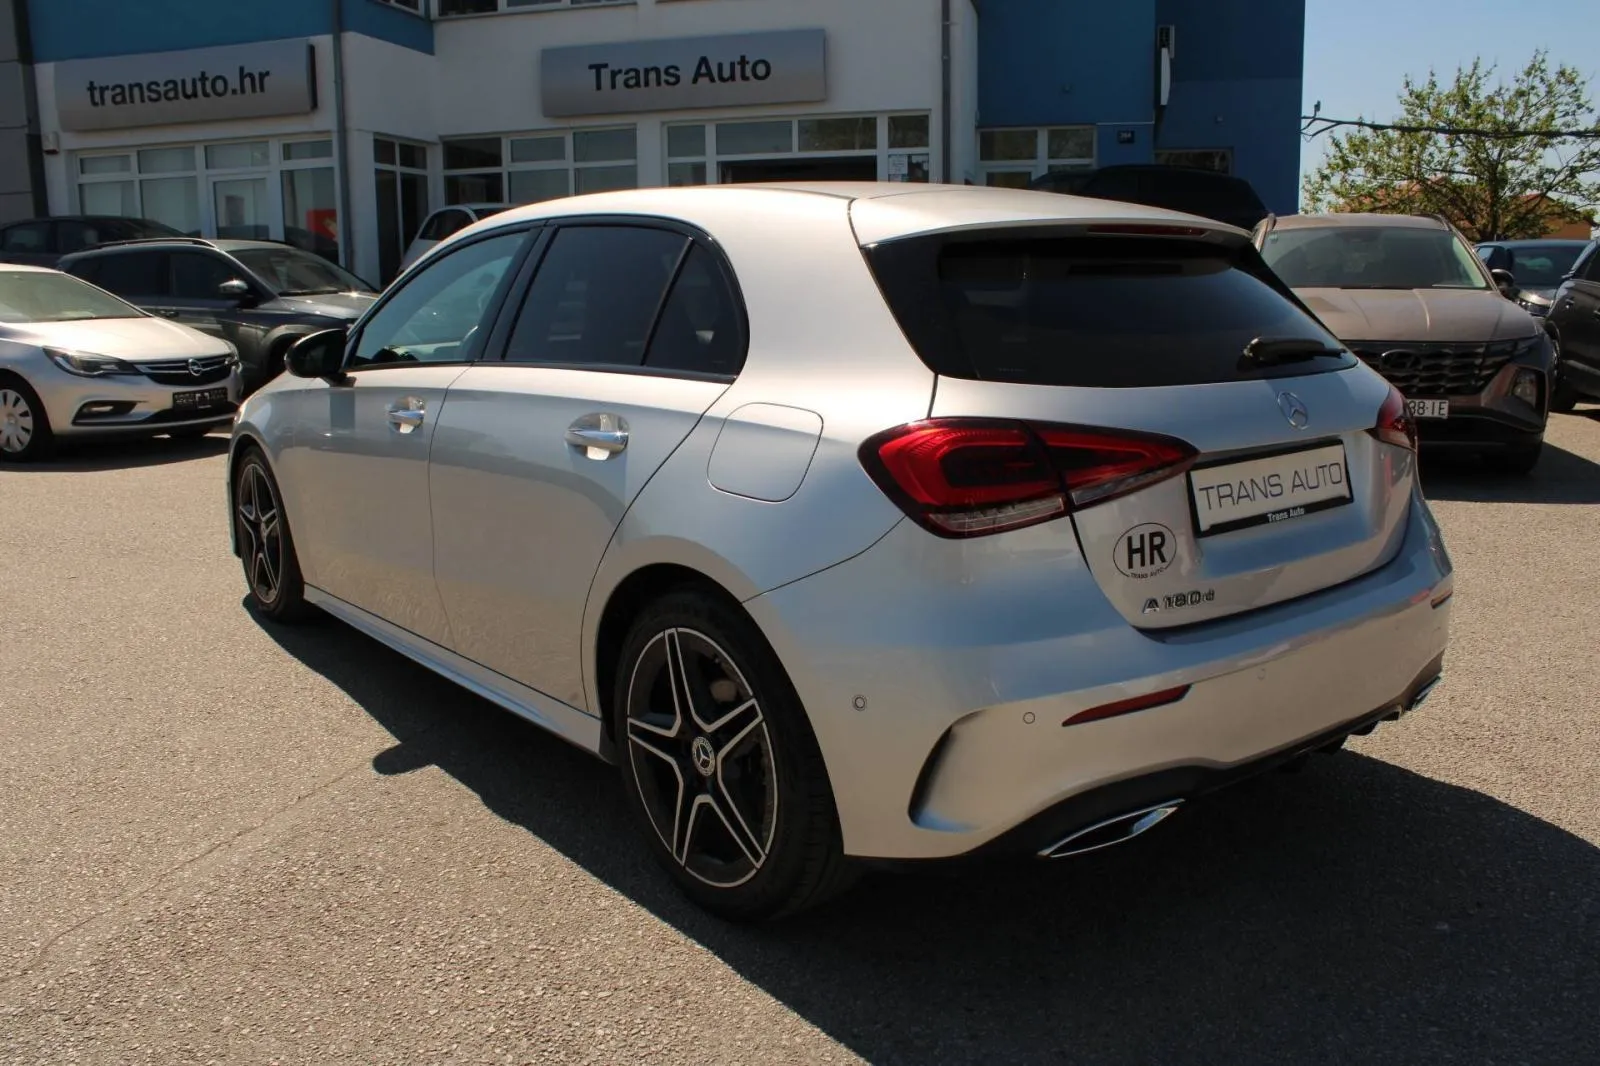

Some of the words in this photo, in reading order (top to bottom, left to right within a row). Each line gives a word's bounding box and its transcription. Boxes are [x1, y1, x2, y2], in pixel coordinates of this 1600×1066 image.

[86, 65, 271, 107] transauto.hr
[588, 63, 681, 91] Trans
[692, 54, 772, 84] Auto
[1199, 474, 1284, 511] TRANS
[1291, 462, 1343, 494] AUTO
[1267, 511, 1289, 523] Trans
[1289, 506, 1305, 519] Auto
[1127, 531, 1166, 569] HR
[1142, 598, 1160, 615] A
